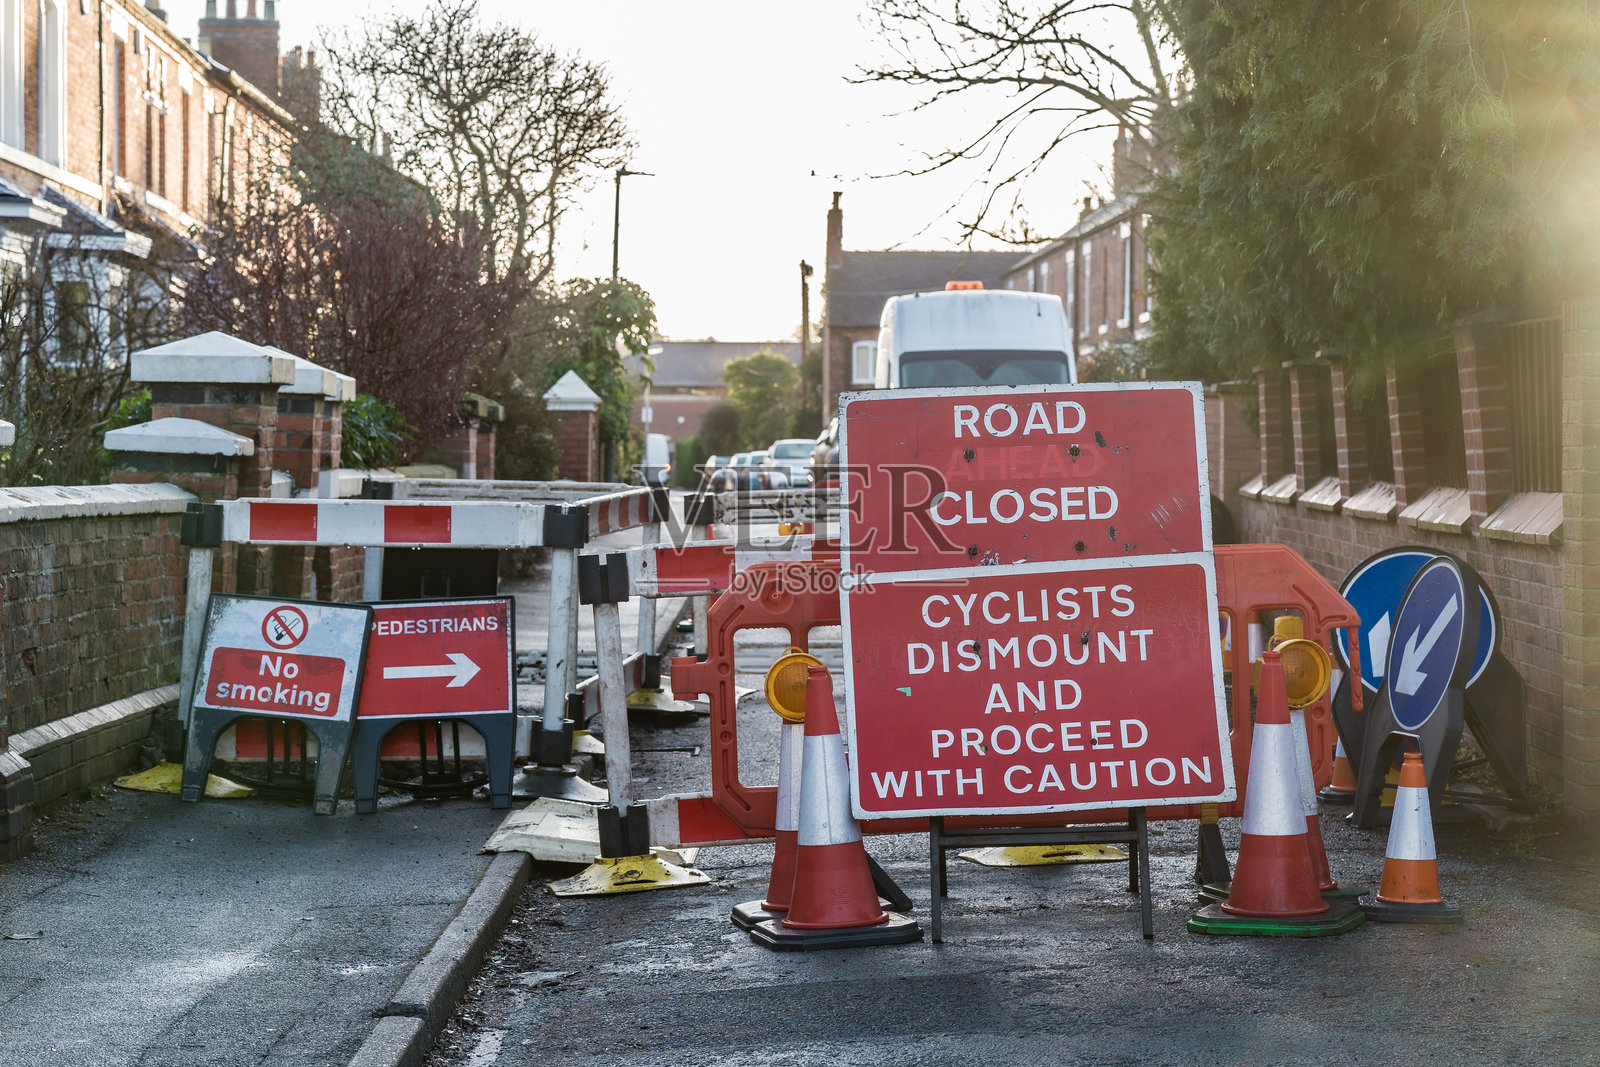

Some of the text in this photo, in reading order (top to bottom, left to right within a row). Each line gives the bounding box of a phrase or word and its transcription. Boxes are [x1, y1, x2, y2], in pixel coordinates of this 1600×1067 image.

[953, 400, 1087, 438] ROAD
[929, 485, 1119, 526] CLOSED
[921, 584, 1135, 629] CYCLISTS
[258, 654, 299, 679] No
[907, 628, 1154, 675] DISMOUNT
[215, 682, 331, 712] smoking
[984, 679, 1082, 715] AND
[931, 718, 1149, 758] PROCEED
[870, 756, 1212, 799] WITH CAUTION
